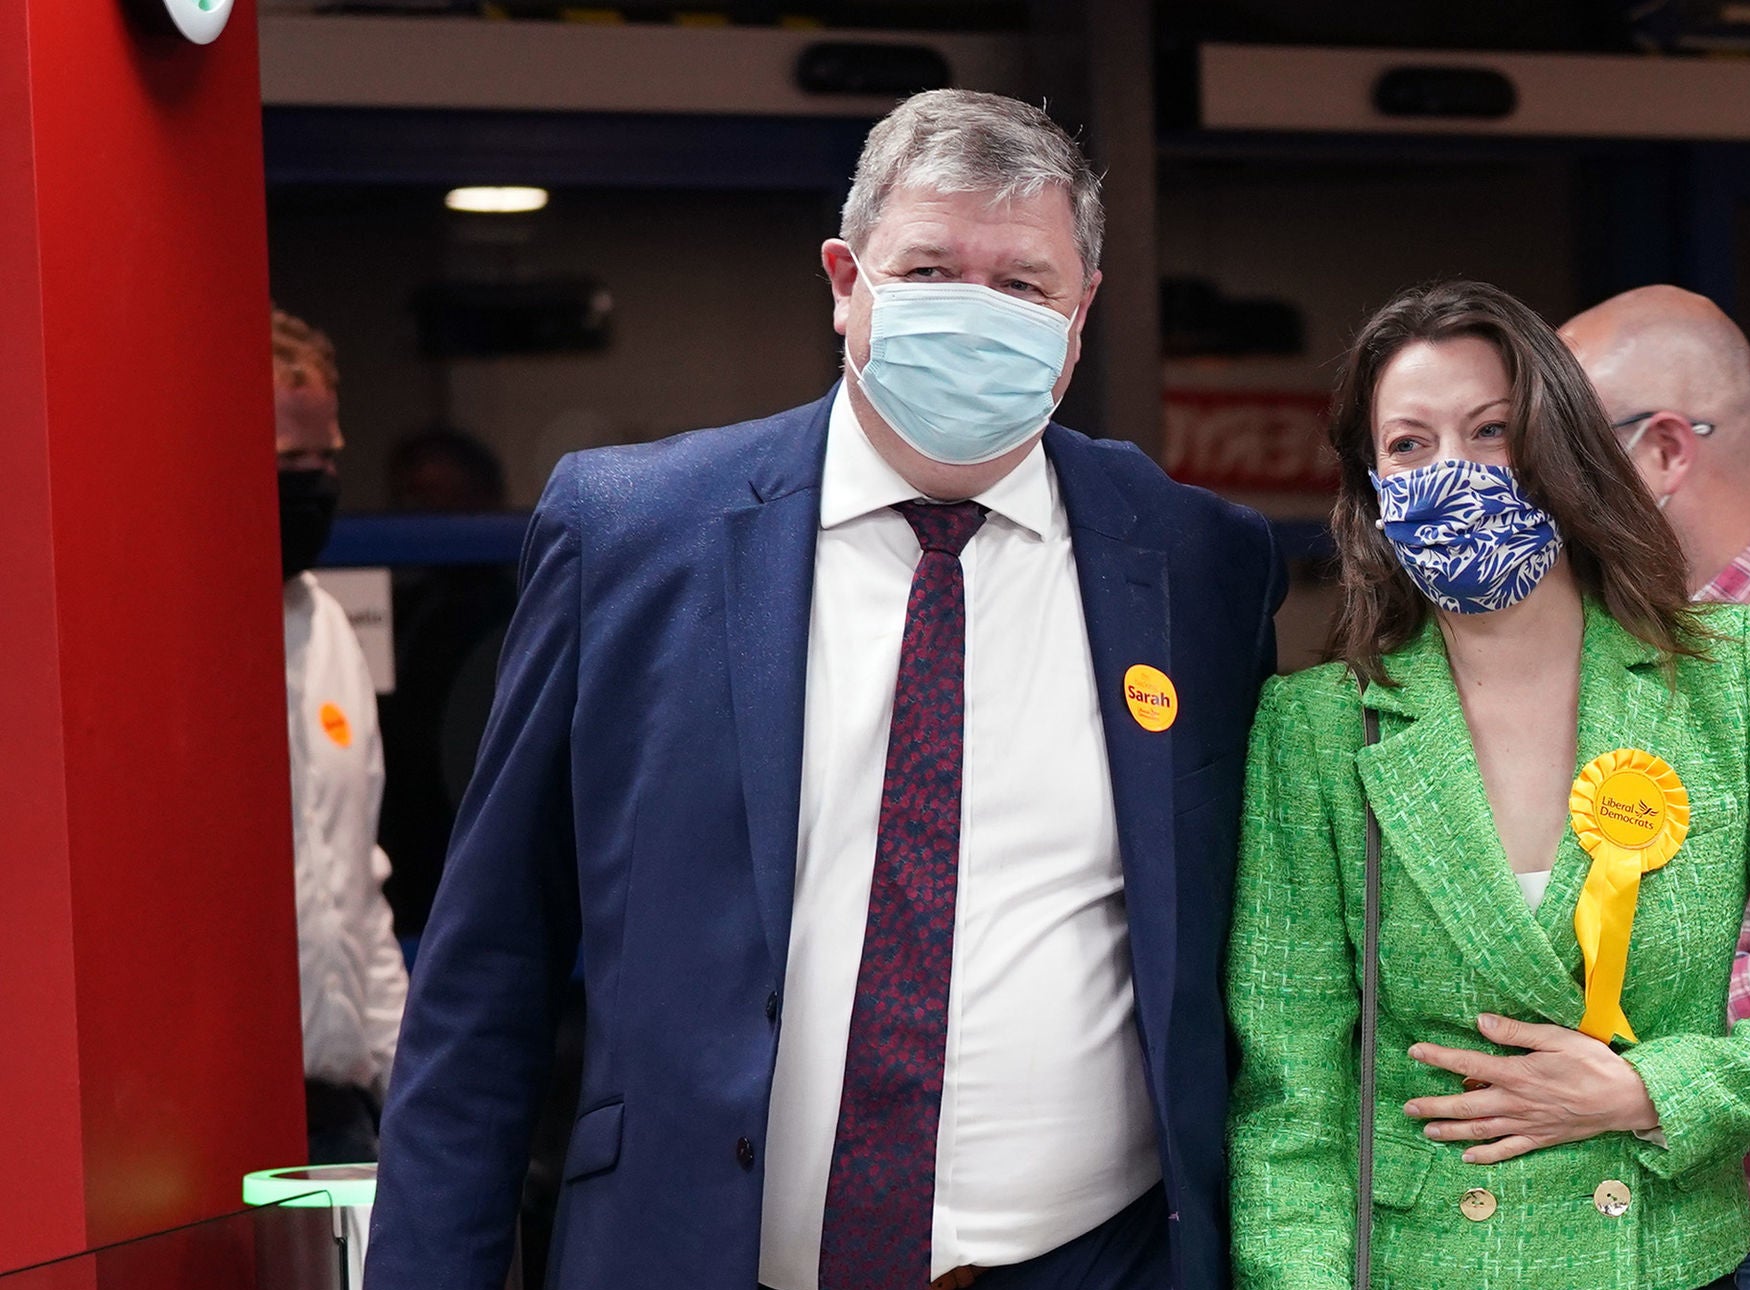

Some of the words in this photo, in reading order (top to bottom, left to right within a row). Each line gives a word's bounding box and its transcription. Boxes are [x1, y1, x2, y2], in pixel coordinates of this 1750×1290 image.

[1128, 685, 1170, 708] Sarah
[1601, 796, 1634, 813] Liberal
[1600, 806, 1654, 830] Democrats
